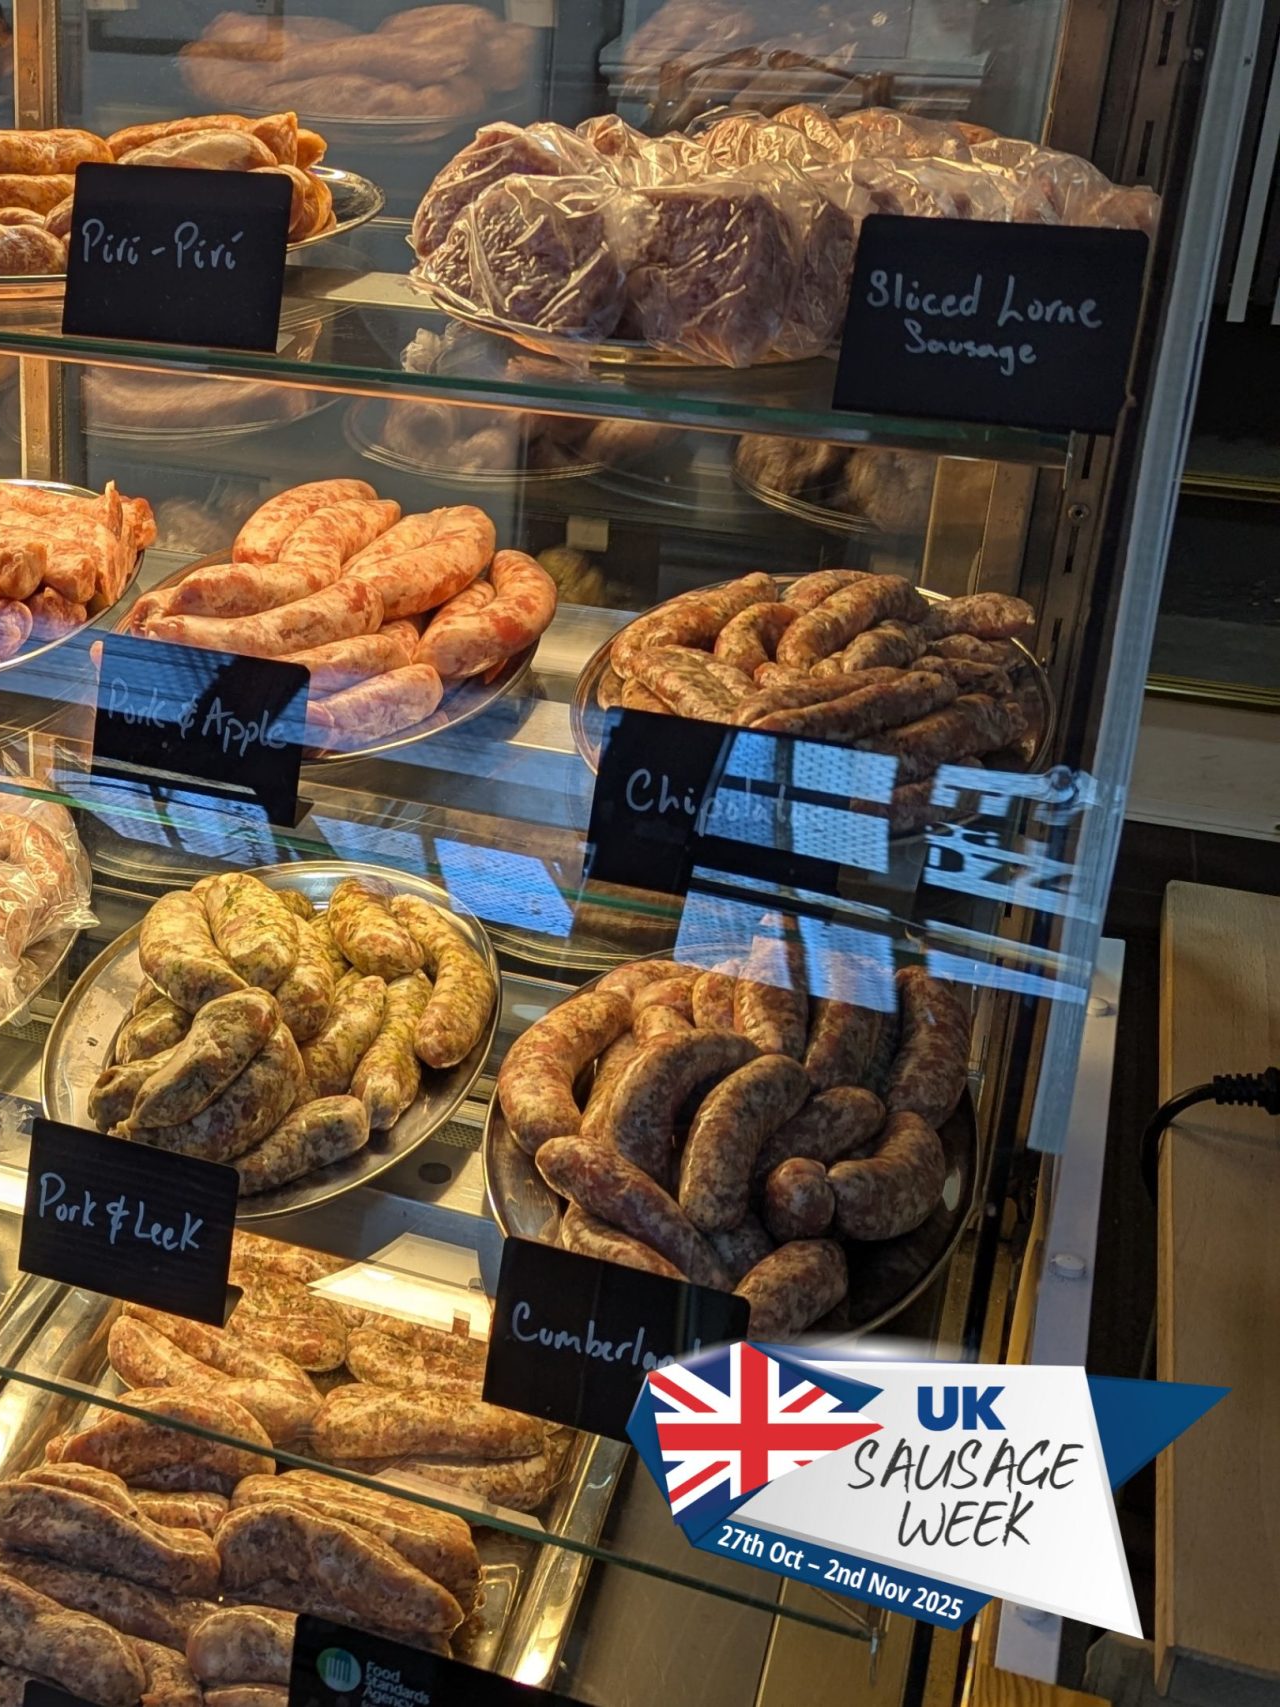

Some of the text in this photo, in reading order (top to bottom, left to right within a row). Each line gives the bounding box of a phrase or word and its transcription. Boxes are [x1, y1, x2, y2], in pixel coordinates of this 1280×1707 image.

[866, 269, 1103, 329] Sliced Lorne
[903, 317, 1037, 377] Sausage
[108, 677, 288, 757] Pork & Apple
[625, 768, 788, 838] Chipolat
[38, 1171, 98, 1227] Pork
[105, 1194, 130, 1245] &
[362, 1685, 415, 1707] Agency
[365, 1673, 430, 1705] Standards
[366, 1660, 401, 1684] Food
